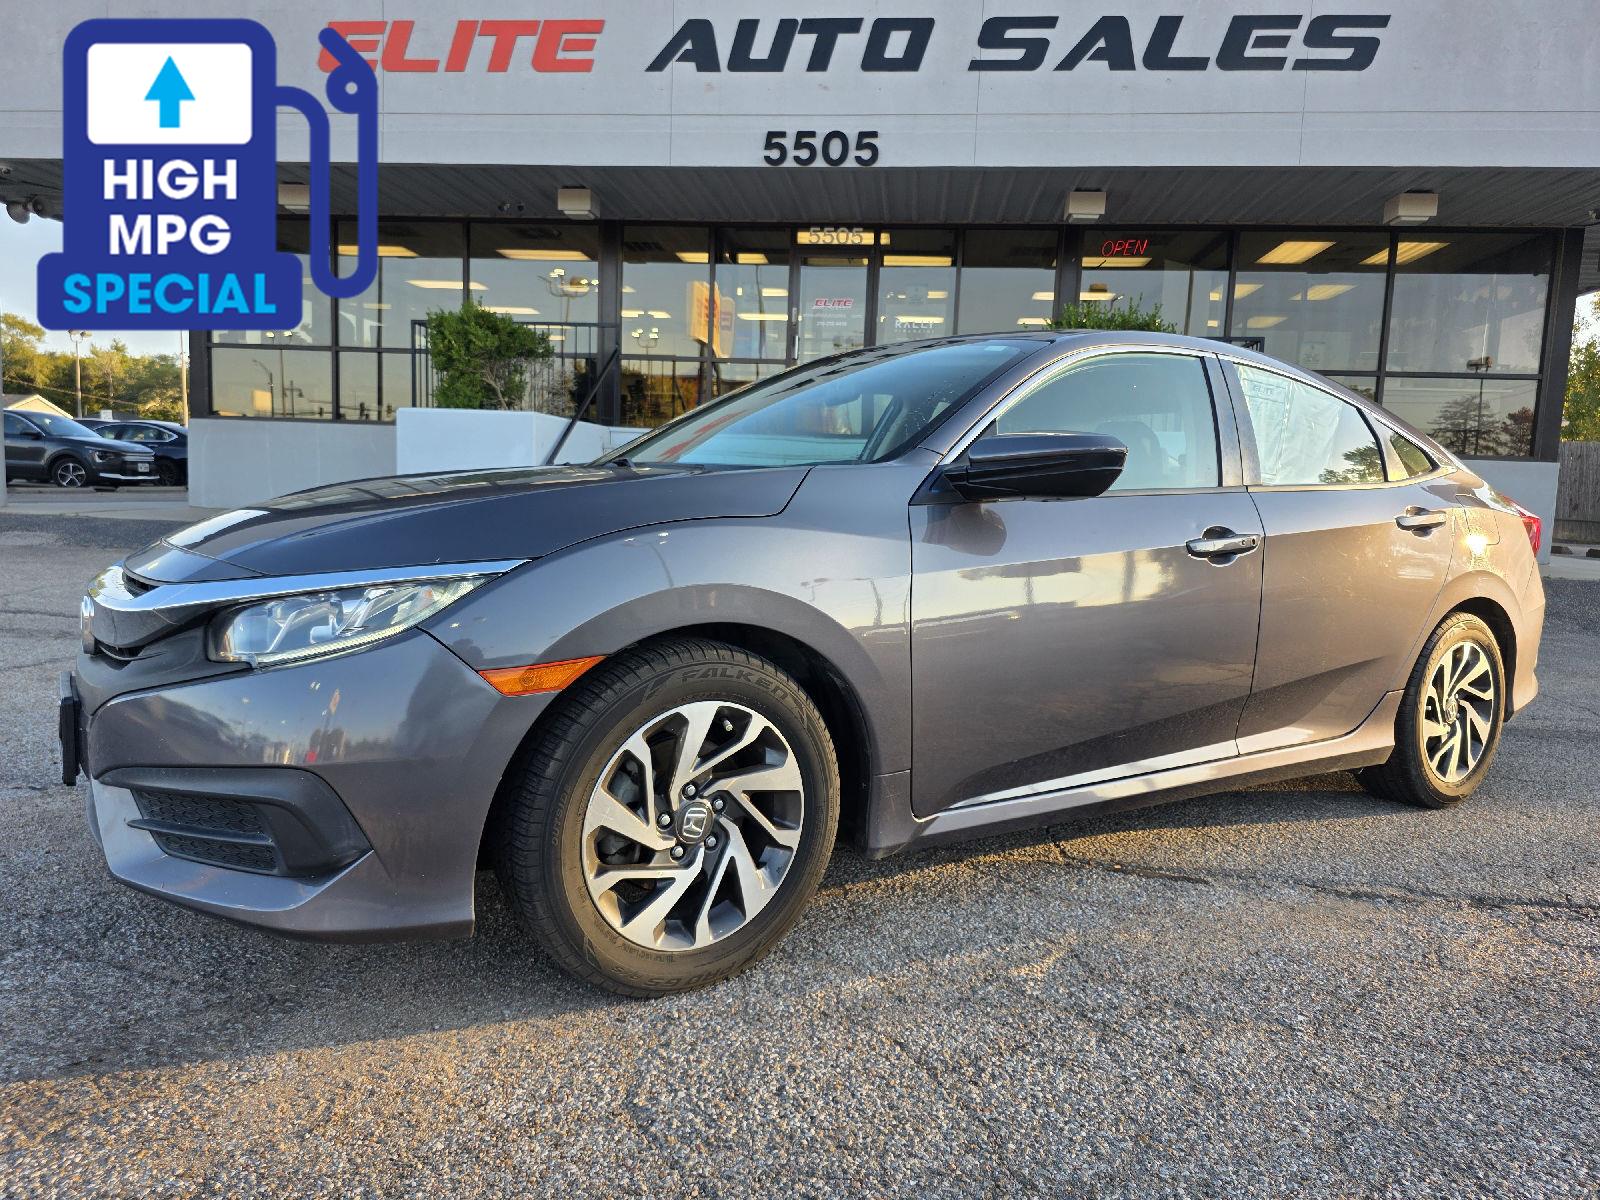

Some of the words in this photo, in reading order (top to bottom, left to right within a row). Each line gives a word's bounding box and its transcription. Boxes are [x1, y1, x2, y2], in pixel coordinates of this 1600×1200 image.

[644, 17, 935, 72] AUTO
[968, 14, 1391, 72] SALES
[763, 130, 879, 167] 5505
[808, 227, 864, 244] 5505
[1101, 239, 1149, 257] OPEN
[814, 298, 853, 308] ELITE
[681, 666, 790, 700] FALKEN
